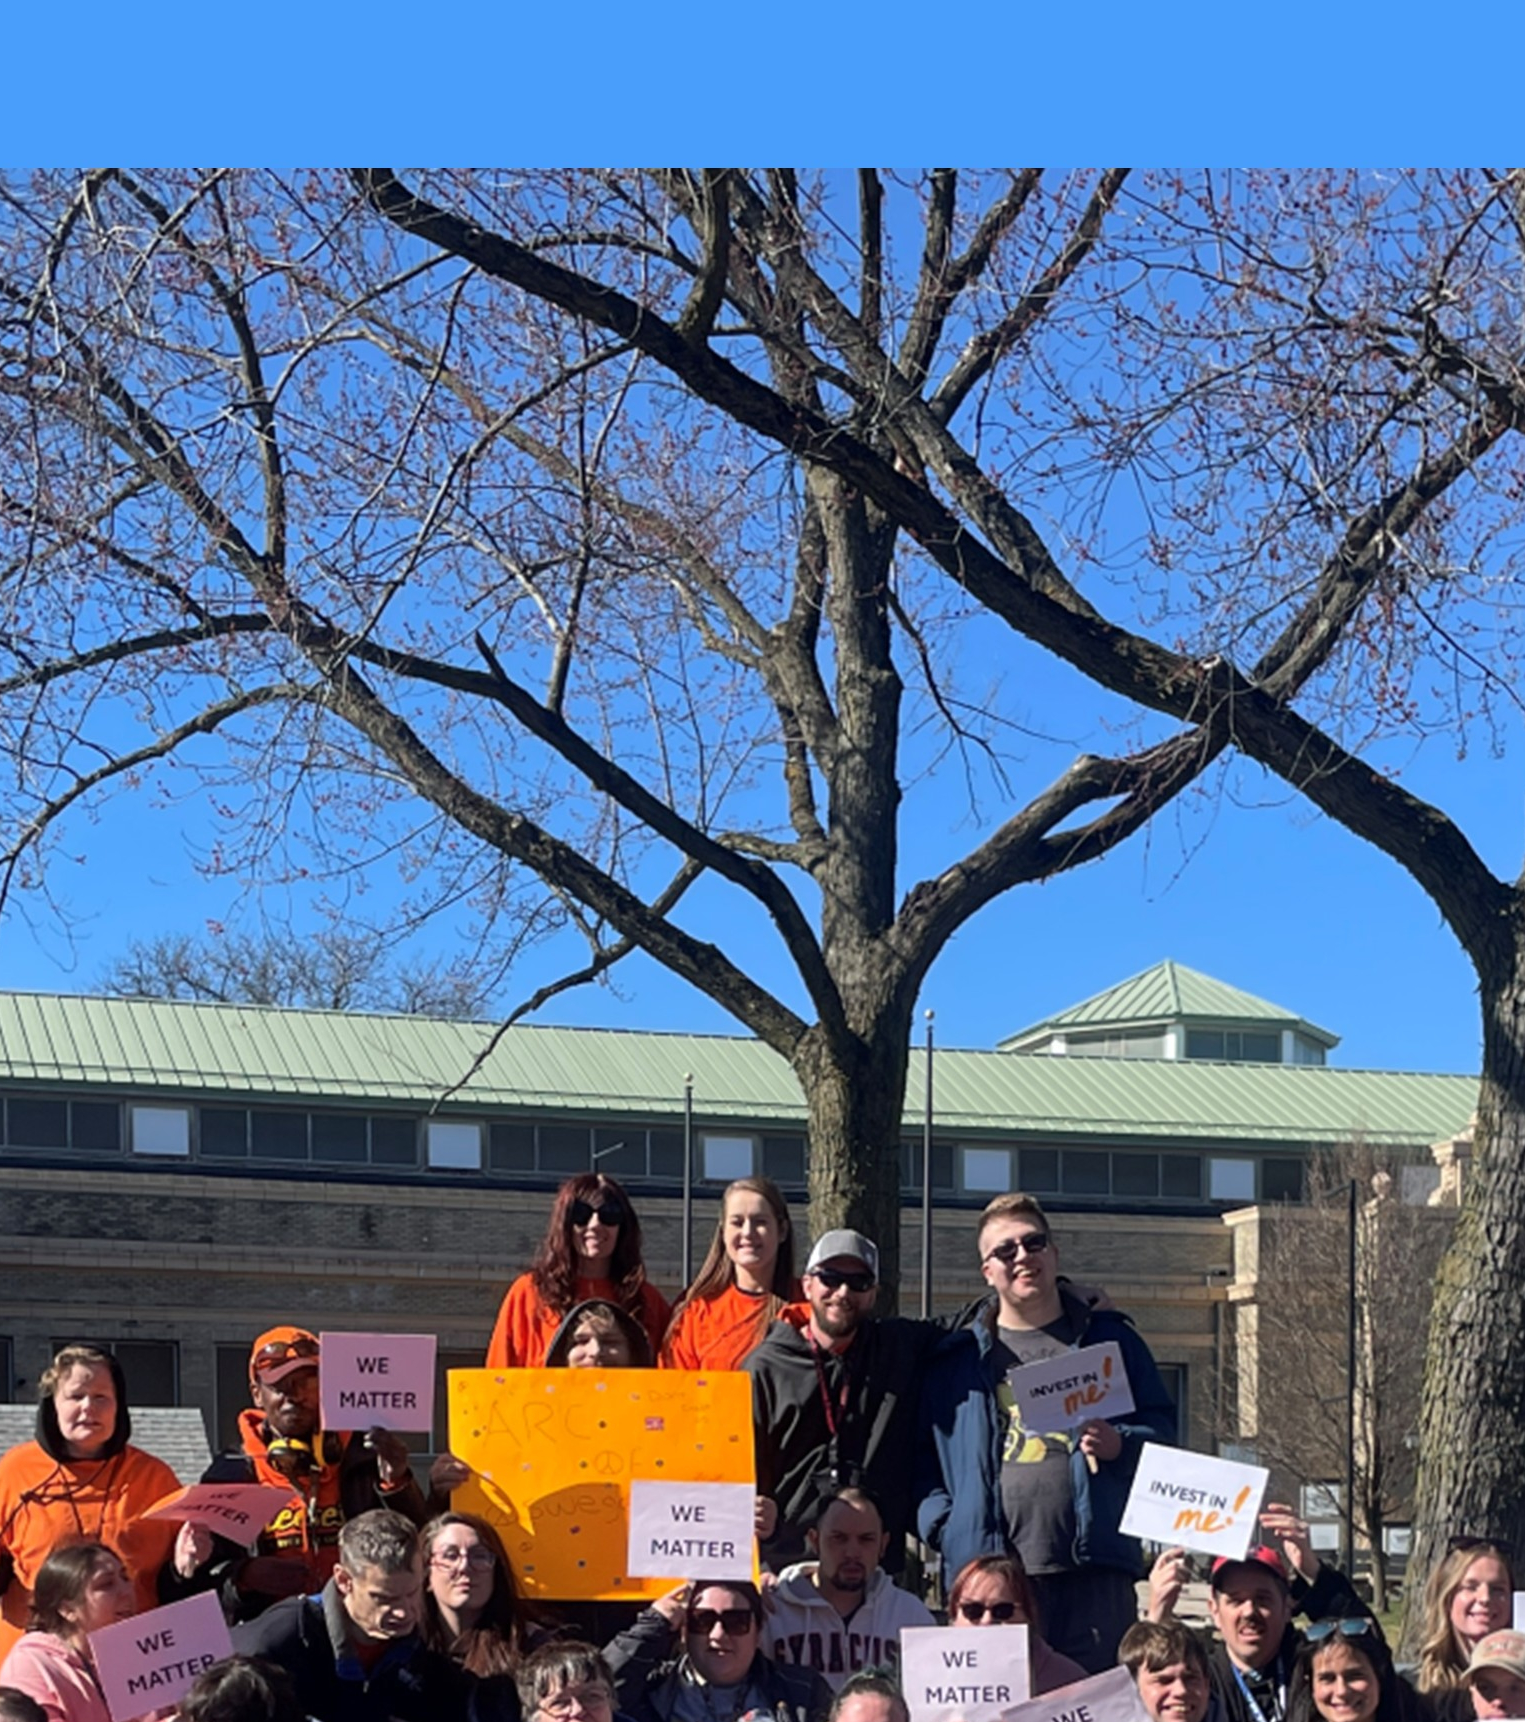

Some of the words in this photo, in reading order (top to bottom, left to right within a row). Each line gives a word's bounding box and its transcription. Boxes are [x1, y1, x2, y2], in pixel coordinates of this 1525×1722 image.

[356, 1357, 389, 1374] WE
[1029, 1376, 1079, 1398] INVEST
[1082, 1371, 1098, 1383] IN
[1064, 1356, 1112, 1416] me!
[339, 1391, 416, 1409] MATTER
[482, 1400, 592, 1447] ARC
[1149, 1480, 1207, 1504] INVEST
[1209, 1495, 1227, 1509] IN
[671, 1505, 706, 1522] WE
[1173, 1485, 1251, 1533] me!
[650, 1539, 735, 1558] MATTER
[136, 1629, 175, 1655] WE
[774, 1631, 899, 1672] SYRACUS
[942, 1650, 978, 1668] WE
[127, 1653, 215, 1695] MATTER
[925, 1685, 1011, 1704] MATTER
